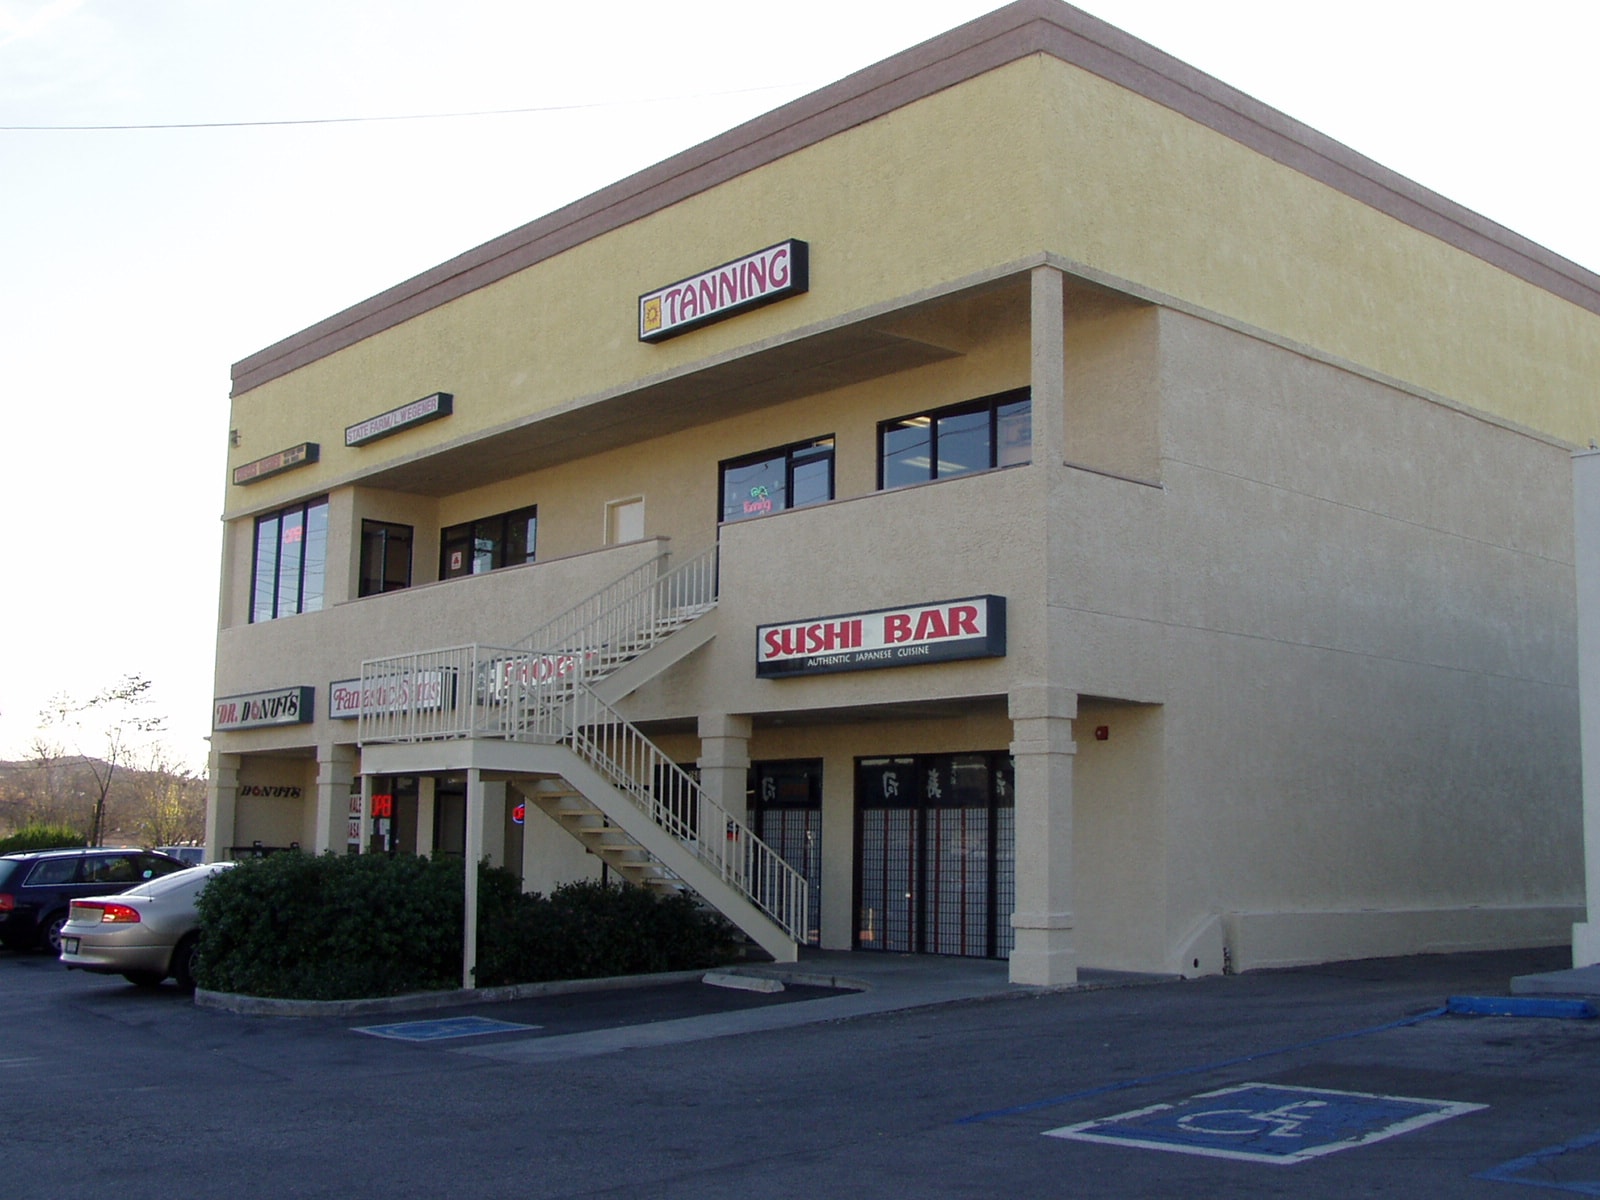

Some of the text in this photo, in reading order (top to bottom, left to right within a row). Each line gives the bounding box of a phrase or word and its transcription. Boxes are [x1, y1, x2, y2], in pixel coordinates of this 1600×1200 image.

[664, 249, 788, 325] TANNING
[764, 605, 981, 659] SUSHI BAR
[807, 645, 929, 667] AUTHENTIC JAPANESE CUISINE
[217, 703, 238, 724] DR.
[241, 785, 301, 799] DONUTS
